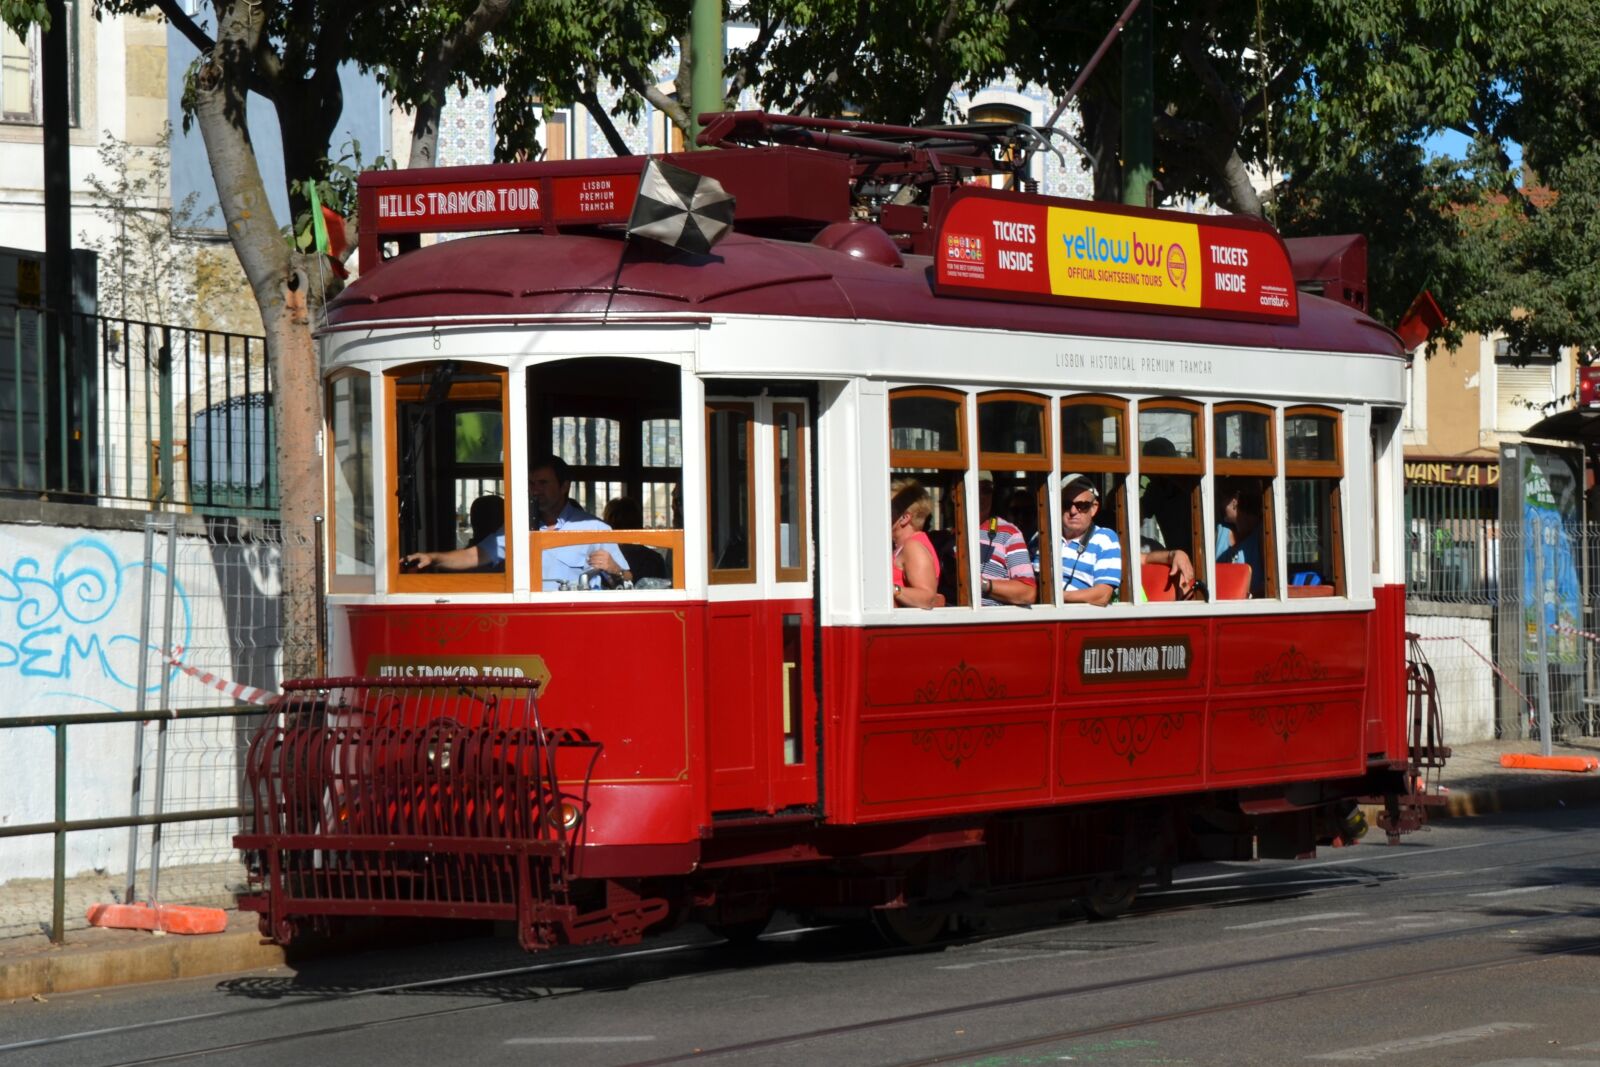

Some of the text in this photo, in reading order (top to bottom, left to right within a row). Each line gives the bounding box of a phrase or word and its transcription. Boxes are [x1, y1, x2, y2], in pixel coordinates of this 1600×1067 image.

[579, 191, 614, 201] PREMIUM
[582, 180, 611, 191] LISBON
[378, 187, 539, 217] HILLS TRAMCAR TOUR
[579, 201, 615, 212] TRAMCAR
[992, 220, 1036, 244] TICKETS
[1132, 231, 1163, 267] bus
[1210, 245, 1248, 267] TICKETS
[998, 250, 1034, 272] INSIDE
[1067, 266, 1162, 287] OFFICIAL SIGHTSEEING TOURS
[1214, 271, 1246, 293] INSIDE
[1055, 353, 1212, 374] LISBON HISTORICAL PREMIUM TRAMCAR
[1083, 645, 1186, 674] HILLS TRAMCAR TOUR
